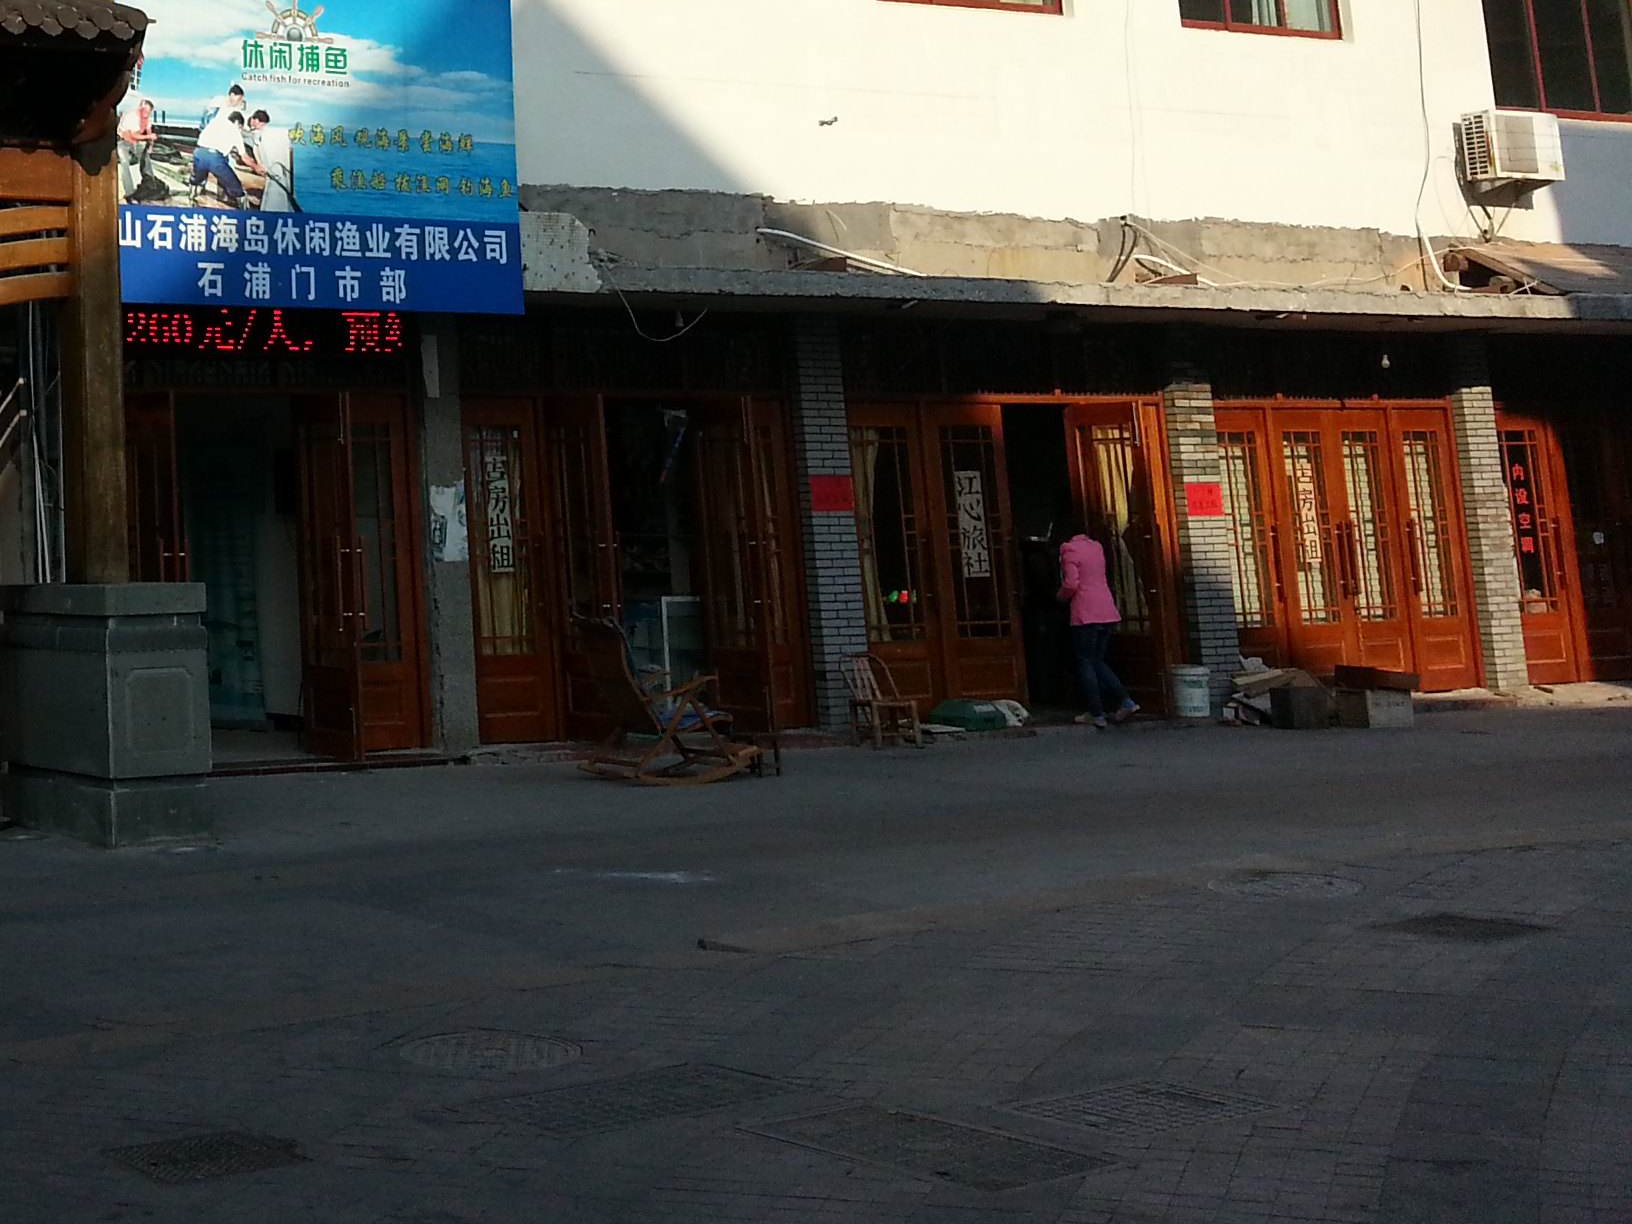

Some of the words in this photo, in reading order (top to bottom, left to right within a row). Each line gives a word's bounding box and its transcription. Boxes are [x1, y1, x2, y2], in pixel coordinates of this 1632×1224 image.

[241, 39, 348, 75] 休闲捕鱼
[241, 72, 268, 81] Catch
[270, 75, 287, 84] fish
[288, 75, 301, 85] for
[303, 77, 350, 88] recreation
[119, 211, 508, 265] 山石浦海岛休闲渔业有限公司
[197, 262, 407, 305] 石浦门市部
